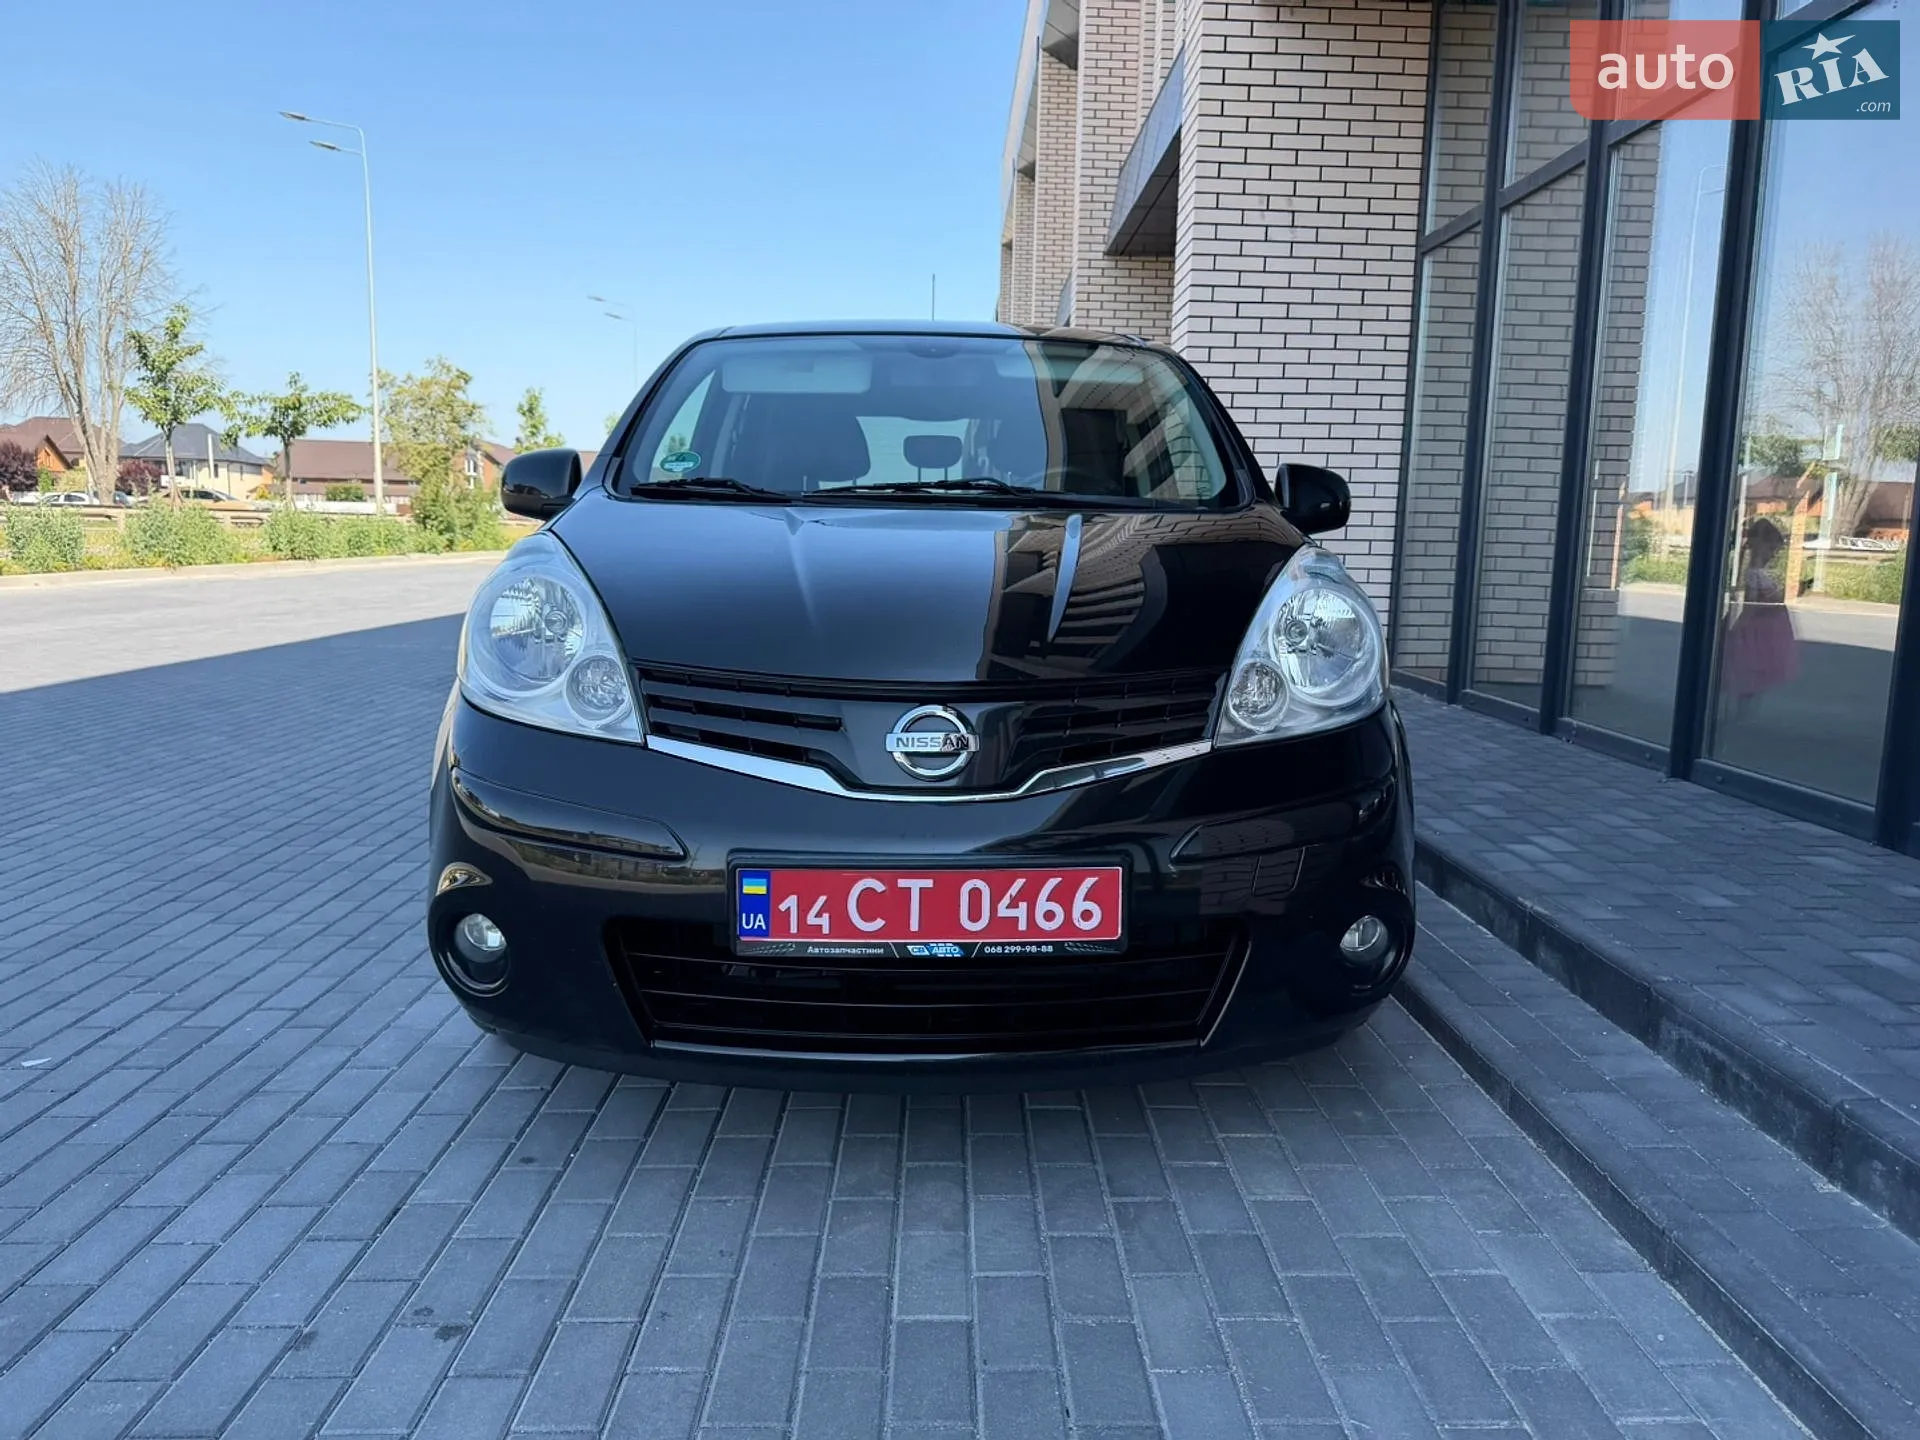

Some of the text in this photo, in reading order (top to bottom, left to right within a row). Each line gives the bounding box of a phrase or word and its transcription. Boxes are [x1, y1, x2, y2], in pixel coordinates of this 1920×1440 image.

[895, 734, 970, 749] NISSAN
[778, 894, 830, 934] 14
[959, 877, 1103, 932] 0466
[742, 912, 767, 930] UA
[984, 945, 1002, 954] 068
